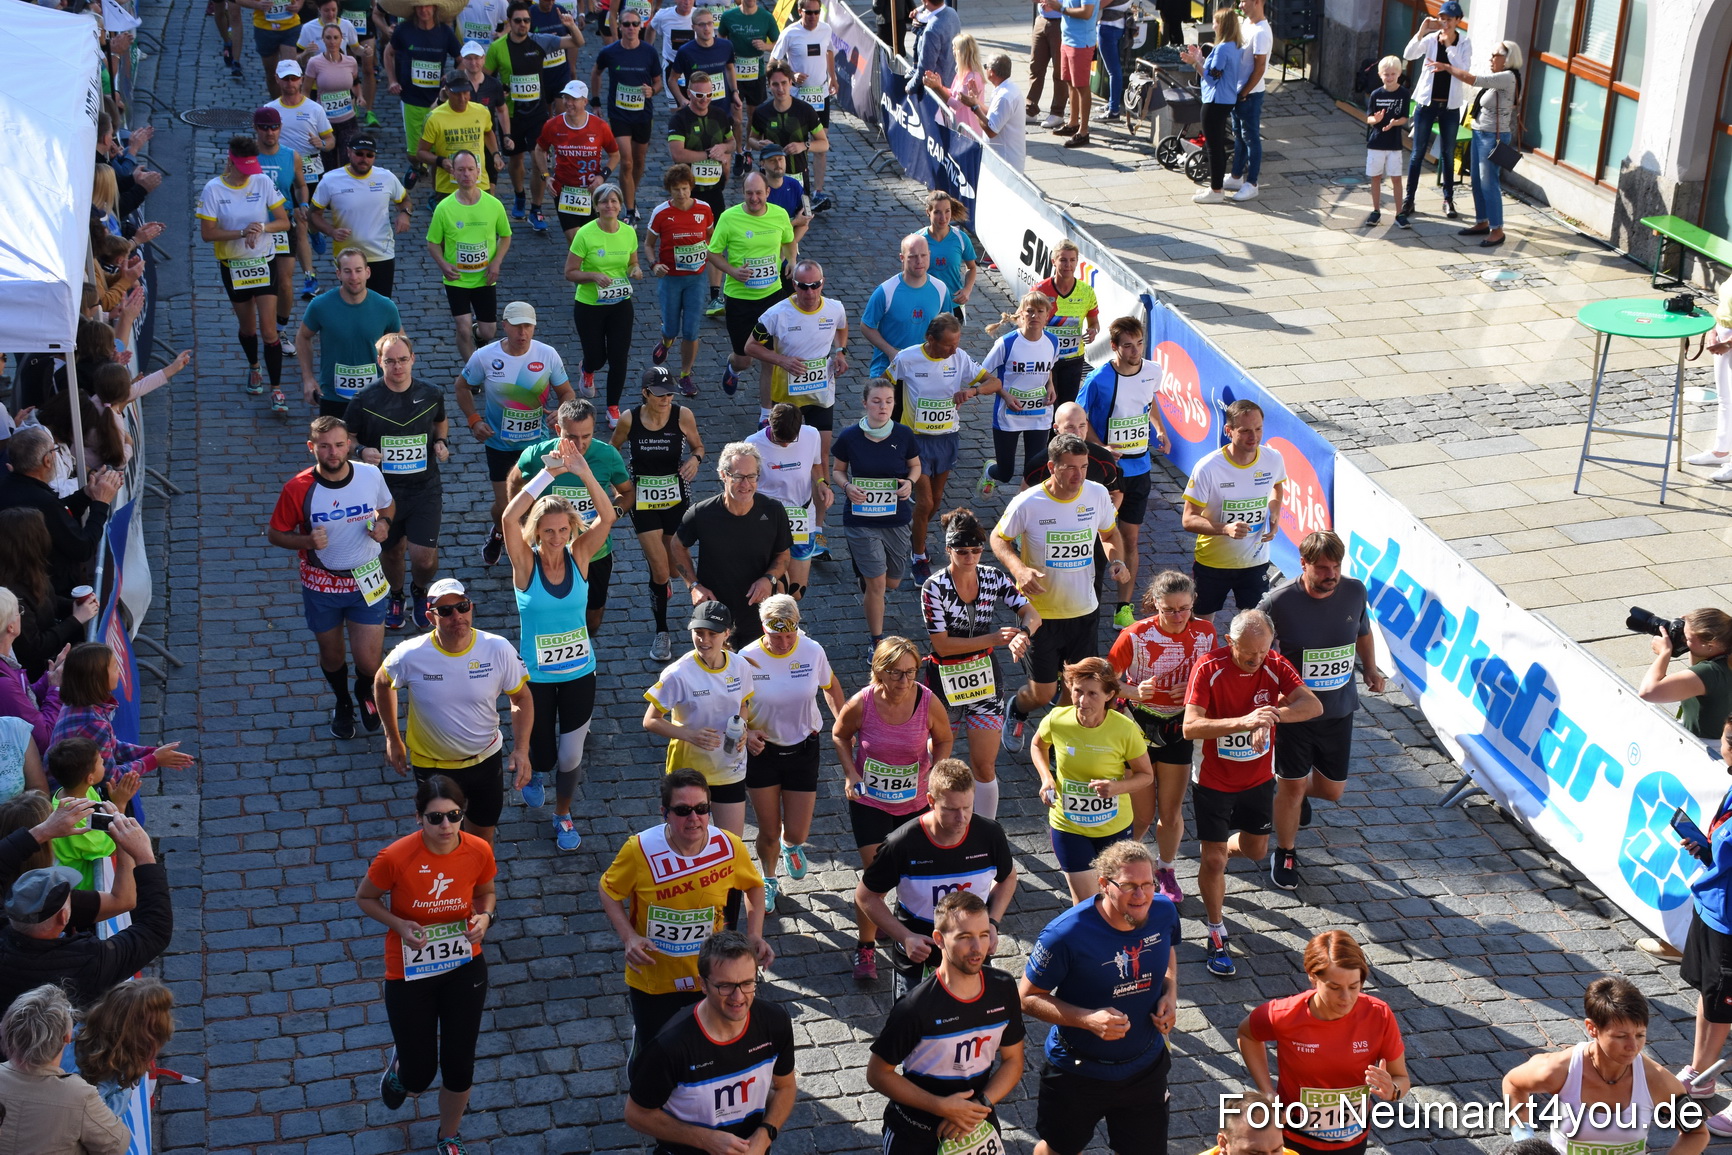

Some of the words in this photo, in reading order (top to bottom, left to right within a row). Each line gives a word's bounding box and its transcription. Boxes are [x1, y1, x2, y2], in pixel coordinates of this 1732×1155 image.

[467, 30, 488, 40] 2190
[415, 69, 440, 80] 1186
[736, 65, 757, 75] 1235
[514, 83, 537, 93] 1109
[620, 93, 643, 103] 1184
[326, 99, 350, 111] 2246
[558, 149, 598, 157] RUNNERS
[578, 160, 597, 173] 20
[695, 167, 721, 176] 1354
[564, 195, 590, 206] 1342
[457, 242, 488, 252] BOCK
[460, 252, 486, 263] 5059
[679, 252, 706, 264] 2070
[235, 267, 266, 279] 1059
[603, 287, 631, 300] 2238
[337, 364, 376, 376] BOCK
[793, 382, 825, 391] WOLFGANG
[1012, 388, 1047, 399] BOCK
[920, 399, 954, 409] BOCK
[1019, 399, 1043, 410] 796
[505, 408, 542, 419] BOCK
[921, 410, 951, 421] 1005
[507, 420, 538, 431] 2188
[925, 423, 945, 431] JOSEF
[1113, 416, 1147, 428] BOCK
[1114, 428, 1145, 441] 1136
[384, 435, 425, 447] BOCK
[387, 448, 422, 461] 2522
[393, 462, 418, 470] FRANK
[640, 476, 679, 487] BOCK
[855, 479, 895, 490] BOCK
[642, 488, 677, 501] 1035
[867, 492, 892, 503] 072
[862, 505, 887, 513] MAREN
[1226, 500, 1266, 511] BOCK
[1280, 477, 1328, 534] ervis
[1227, 511, 1263, 524] 2323
[1049, 530, 1090, 543] BOCK
[1052, 544, 1089, 558] 2290
[1052, 559, 1088, 569] HERBERT
[540, 629, 583, 647] BOCK
[543, 644, 585, 664] 2722
[1308, 647, 1351, 660] BOCK
[468, 660, 480, 670] 20
[469, 667, 494, 675] Neumarkter
[790, 662, 800, 670] 20
[946, 656, 992, 675] BOCK
[1309, 660, 1349, 677] 2289
[948, 670, 990, 691] 1081
[1314, 677, 1344, 687] STEFAN
[954, 689, 988, 702] MELANIE
[1228, 748, 1254, 758] RUDO
[868, 761, 918, 776] BOCK
[869, 775, 913, 791] 2184
[875, 790, 904, 800] HELGA
[1068, 797, 1113, 812] 2208
[1070, 812, 1113, 823] GERLINDE
[656, 880, 696, 901] MAX
[699, 865, 734, 888] BÖGL
[412, 897, 462, 909] funrunners
[427, 902, 468, 914] neumarkt
[652, 907, 707, 922] BOCK
[420, 923, 463, 939] OCK
[655, 924, 705, 941] 2372
[411, 940, 465, 963] 2134
[653, 940, 703, 953] CHRISTOP
[416, 960, 461, 973] MELANIE
[953, 1034, 992, 1064] mr
[1297, 1046, 1315, 1054] FEHR
[1353, 1040, 1368, 1049] SVS
[713, 1076, 756, 1110] mr
